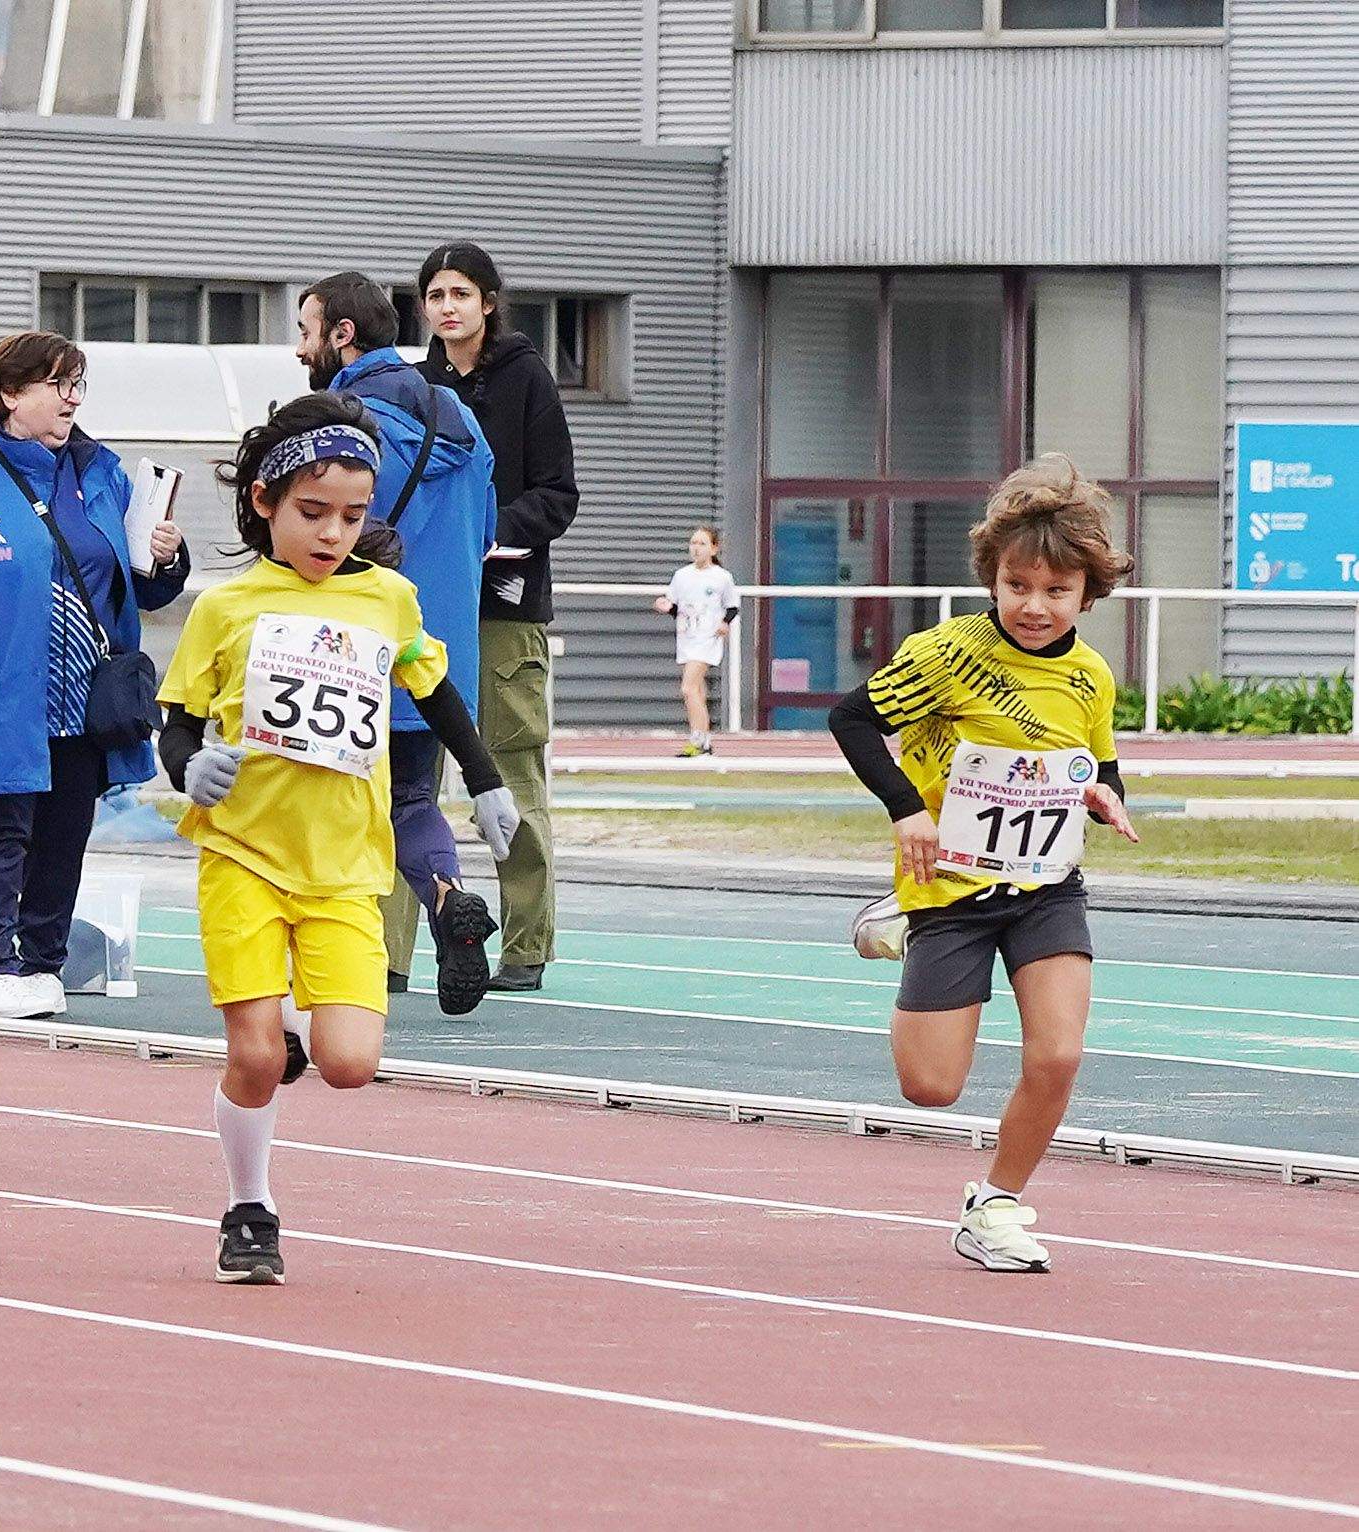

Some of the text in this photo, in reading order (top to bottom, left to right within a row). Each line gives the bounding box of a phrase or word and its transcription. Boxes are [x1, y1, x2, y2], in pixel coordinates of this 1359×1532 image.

[251, 660, 285, 673] GRAN
[287, 666, 332, 683] PREMIO
[334, 676, 354, 690] JIM
[260, 648, 277, 659] VII
[279, 652, 327, 669] TORNEO
[329, 663, 344, 674] DE
[346, 667, 367, 681] REIS
[262, 673, 380, 750] 353
[949, 786, 981, 800] GRAN
[983, 793, 1027, 807] PREMIO
[958, 777, 975, 787] VII
[977, 781, 1022, 796] TORNEO
[1024, 788, 1039, 797] DE
[976, 806, 1069, 857] 117
